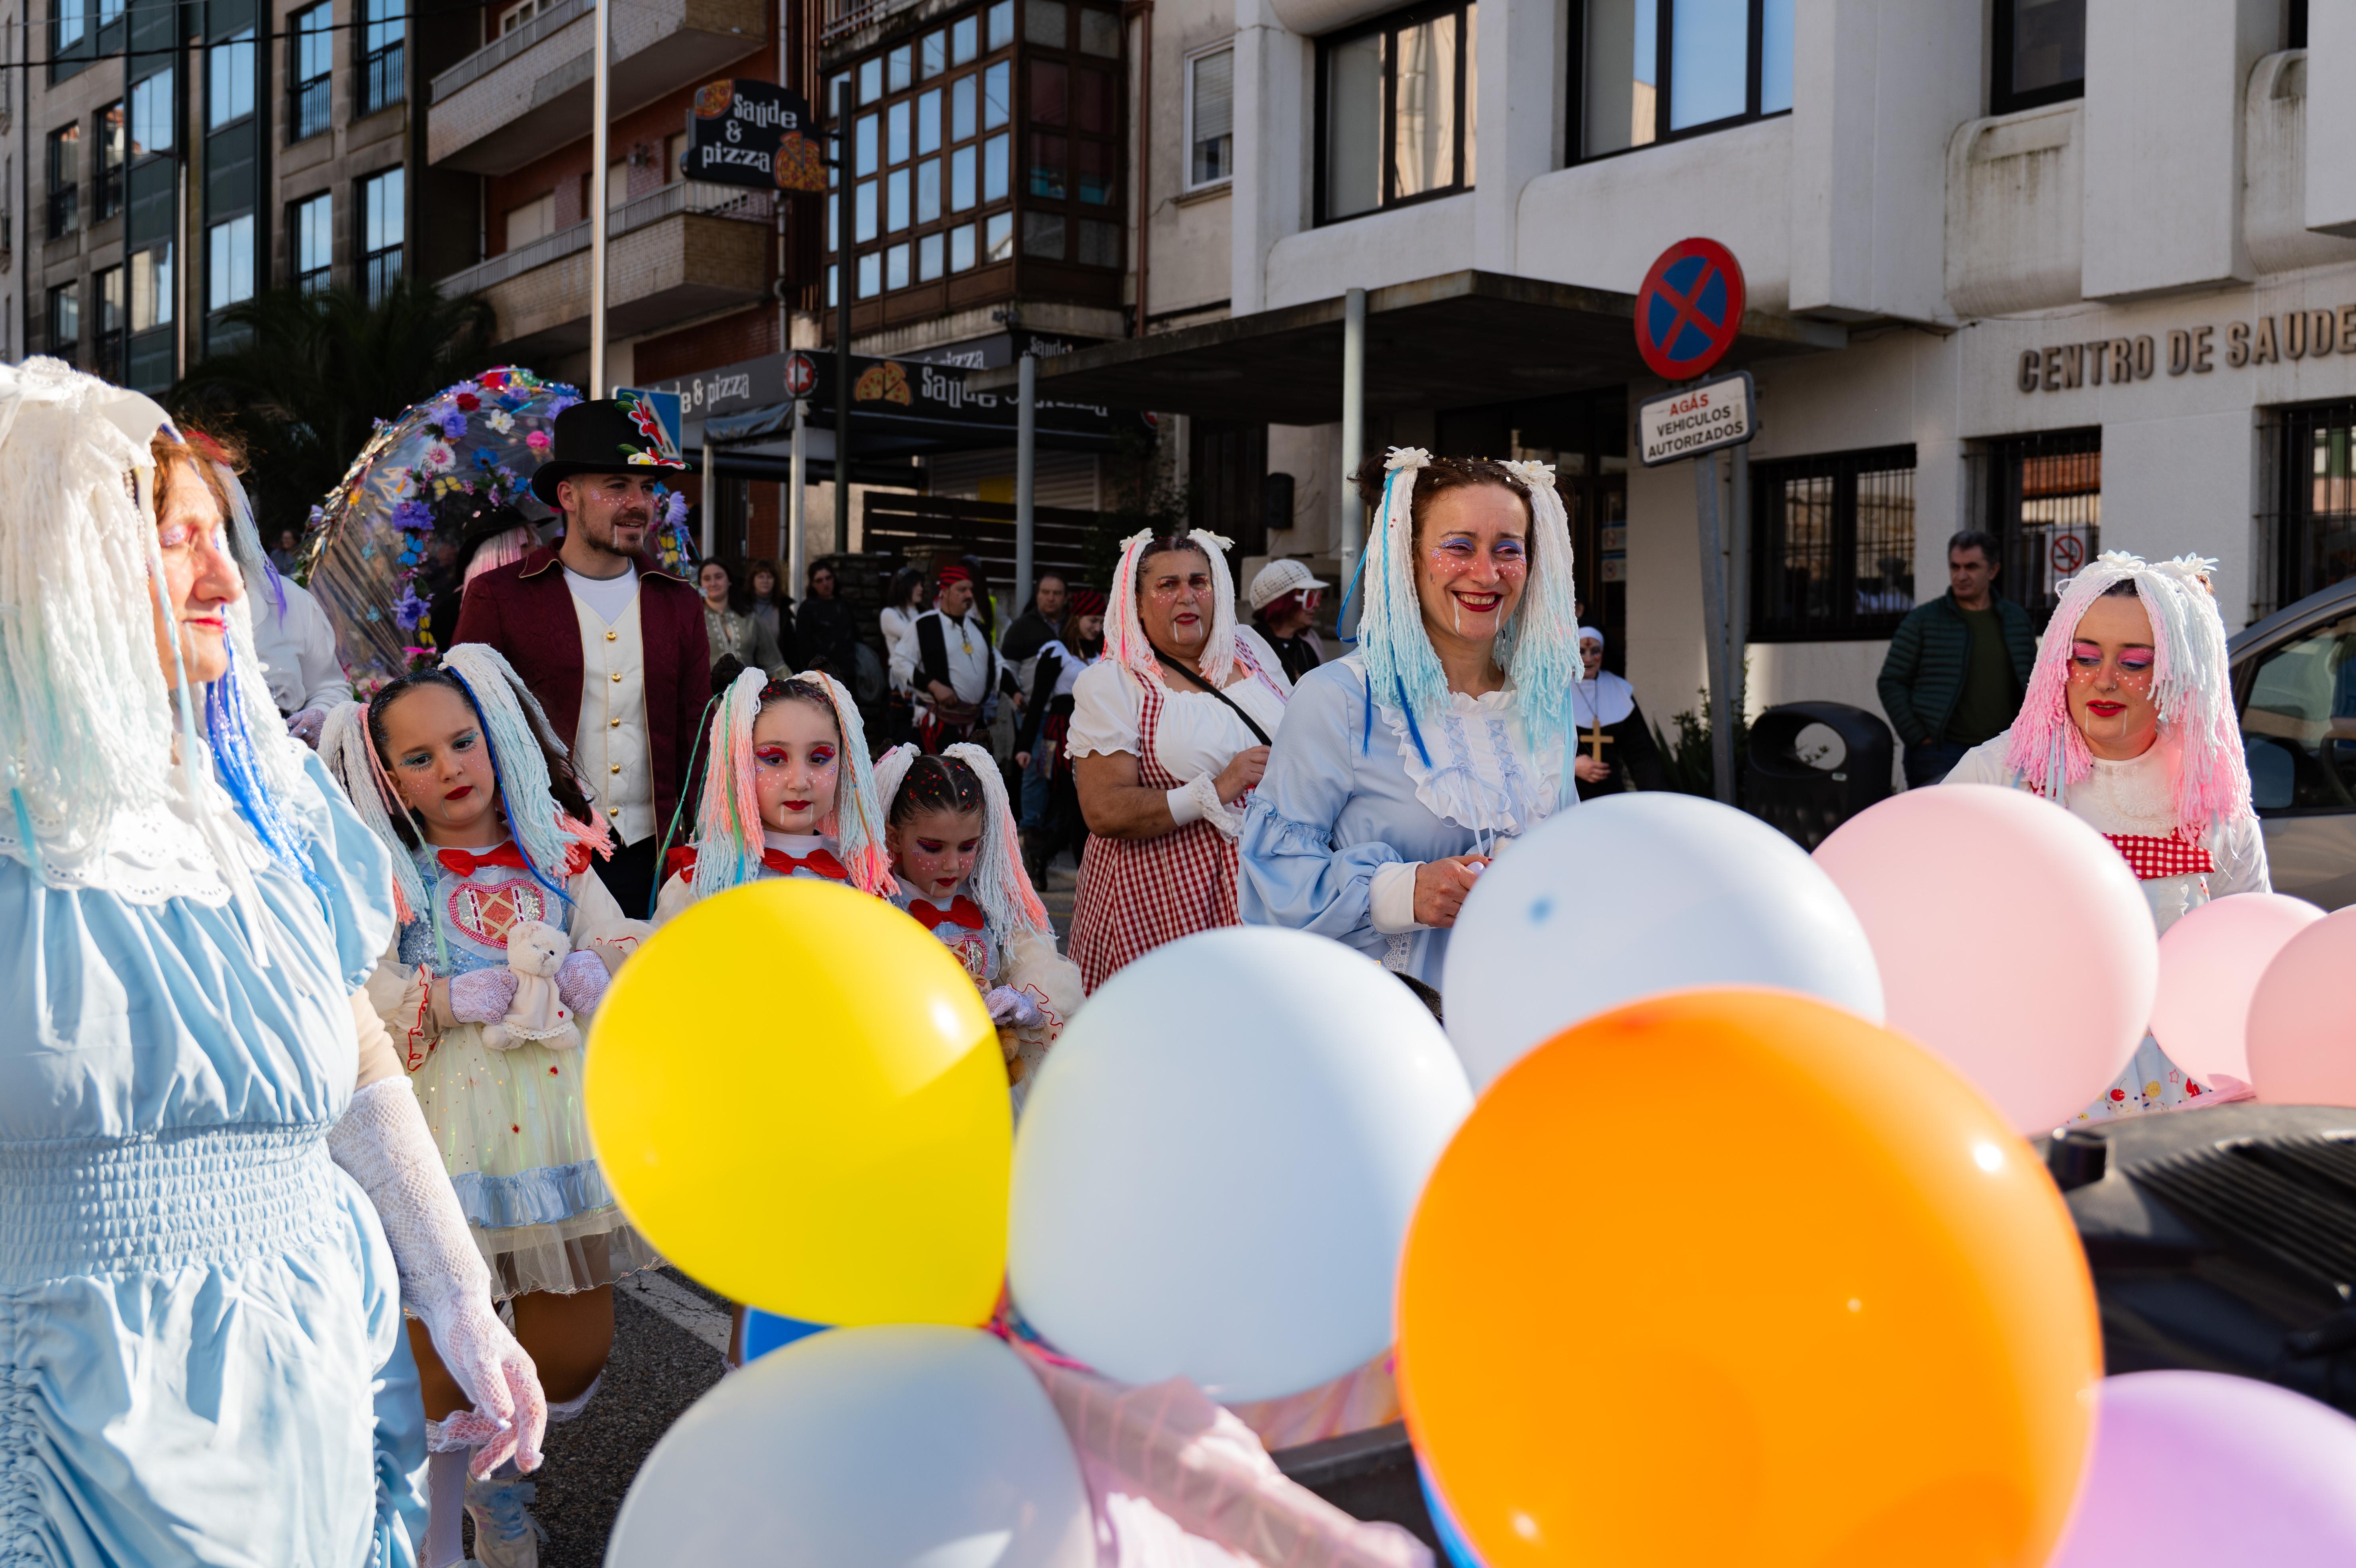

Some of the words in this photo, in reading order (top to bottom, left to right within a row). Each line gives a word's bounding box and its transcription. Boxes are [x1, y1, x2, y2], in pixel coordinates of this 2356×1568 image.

[733, 93, 797, 129] Saúde
[725, 119, 743, 143] &
[702, 141, 771, 173] pizza
[2018, 335, 2154, 392] CENTRO
[2167, 326, 2213, 376] DE
[693, 378, 704, 405] &
[708, 374, 750, 412] pizza
[1670, 393, 1709, 417] AGÁS
[1657, 405, 1731, 437] VEHICULOS
[1648, 421, 1743, 458] AUTORIZADOS
